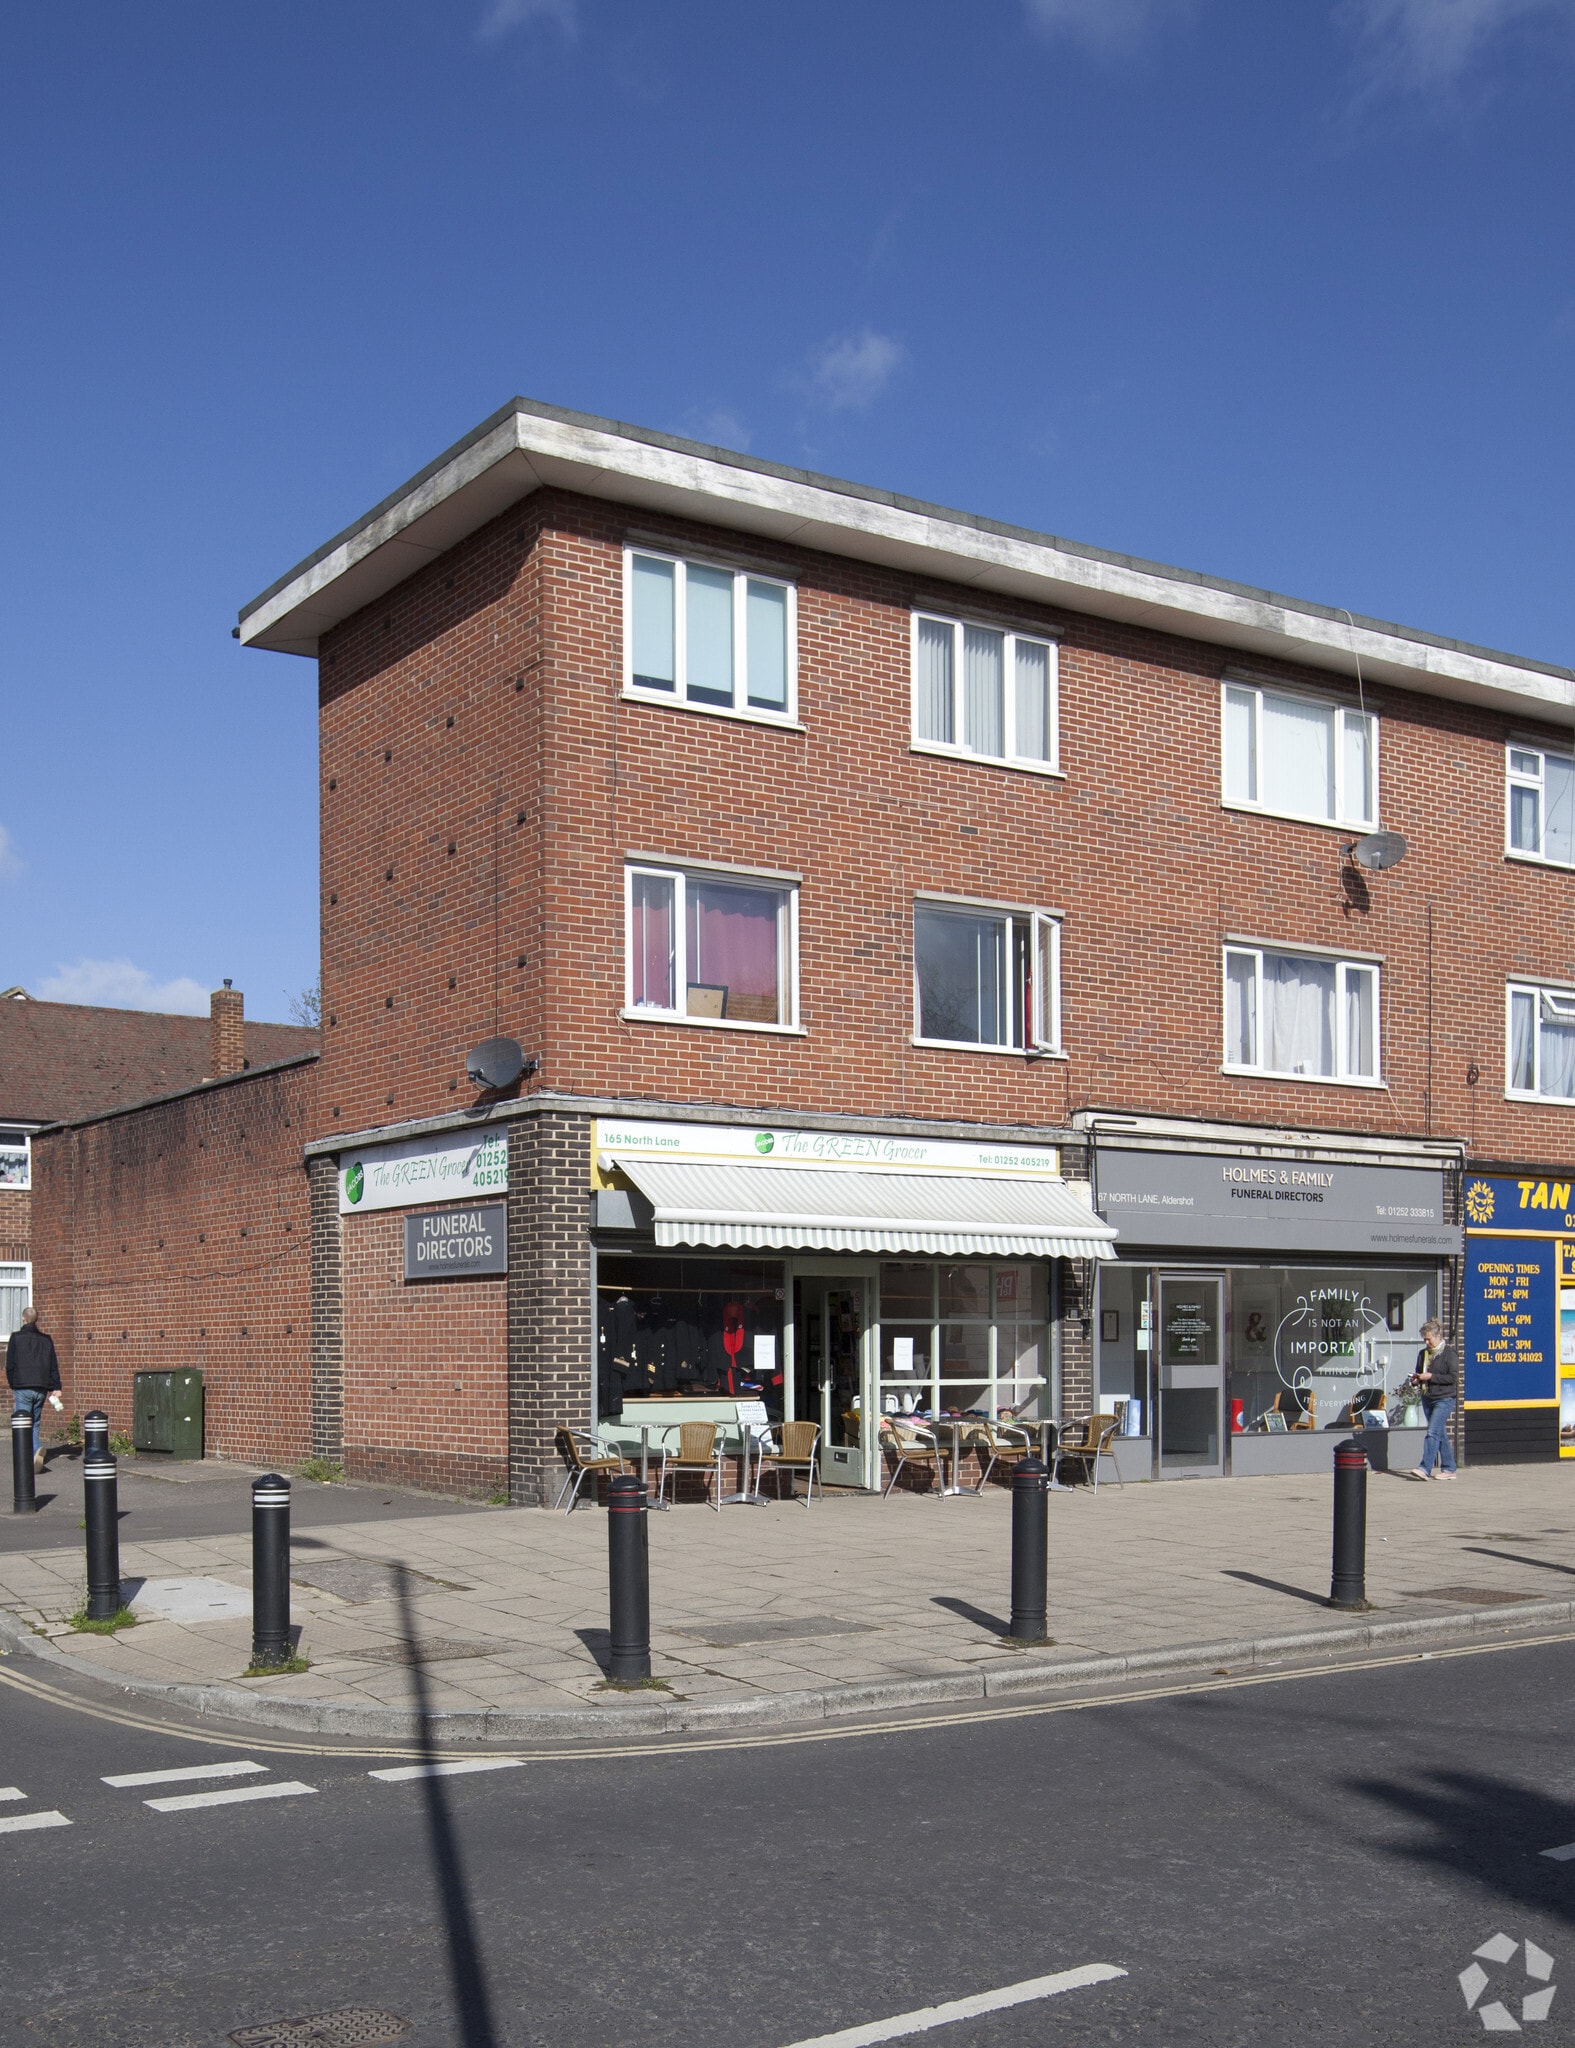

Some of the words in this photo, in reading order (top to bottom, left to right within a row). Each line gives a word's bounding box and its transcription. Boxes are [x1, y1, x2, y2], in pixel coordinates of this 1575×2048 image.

[483, 1132, 500, 1149] Tel:
[604, 1133, 622, 1144] 165
[624, 1134, 653, 1145] North
[655, 1136, 680, 1147] Lane
[782, 1130, 809, 1153] The
[813, 1135, 881, 1158] GREEN
[883, 1140, 928, 1161] Grocer
[477, 1149, 507, 1168] 01252
[979, 1154, 993, 1164] Tel:
[994, 1155, 1019, 1166] 01252
[1020, 1157, 1050, 1167] 405219
[374, 1162, 390, 1187] The
[393, 1158, 438, 1187] GREEN
[473, 1168, 509, 1187] 405219
[1222, 1167, 1276, 1184] HOLMES
[1280, 1170, 1289, 1185] &
[1291, 1171, 1334, 1187] FAMILY
[347, 1169, 363, 1195] JACOBS
[1097, 1192, 1107, 1202] 67
[1109, 1193, 1137, 1203] NORTH
[1138, 1194, 1160, 1205] LANE,
[1161, 1195, 1194, 1206] Aldershot
[1231, 1188, 1274, 1200] FUNERAL
[1275, 1190, 1324, 1202] DIRECTORS
[1517, 1181, 1571, 1210] TAN
[1376, 1205, 1387, 1215] Tel:
[1387, 1206, 1409, 1217] 01252
[1409, 1208, 1435, 1218] 333815
[423, 1212, 486, 1238] FUNERAL
[1370, 1234, 1453, 1245] www.holmesfunerals.com
[417, 1235, 493, 1262] DIRECTORS
[1478, 1262, 1515, 1274] OPENING
[1516, 1263, 1540, 1274] TIMES
[1489, 1276, 1508, 1286] MON
[1515, 1276, 1529, 1287] FRI
[1310, 1288, 1360, 1302] FAMILY
[1484, 1288, 1505, 1299] 12PM
[1501, 1301, 1517, 1312] SAT
[1308, 1319, 1318, 1328] IS
[1321, 1319, 1341, 1328] NOT
[1345, 1319, 1359, 1328] AN
[1487, 1314, 1508, 1325] 10AM
[1515, 1314, 1531, 1325] 6PM
[1501, 1327, 1518, 1337] SUN
[1290, 1341, 1377, 1354] IMPORTANT
[1488, 1340, 1508, 1350] 11AM
[1515, 1340, 1531, 1350] 3PM
[1476, 1352, 1493, 1362] TEL:
[1495, 1352, 1517, 1362] 01252
[1518, 1352, 1543, 1362] 341023
[1319, 1366, 1350, 1376] THING
[1319, 1395, 1367, 1408] EVERYTHING
